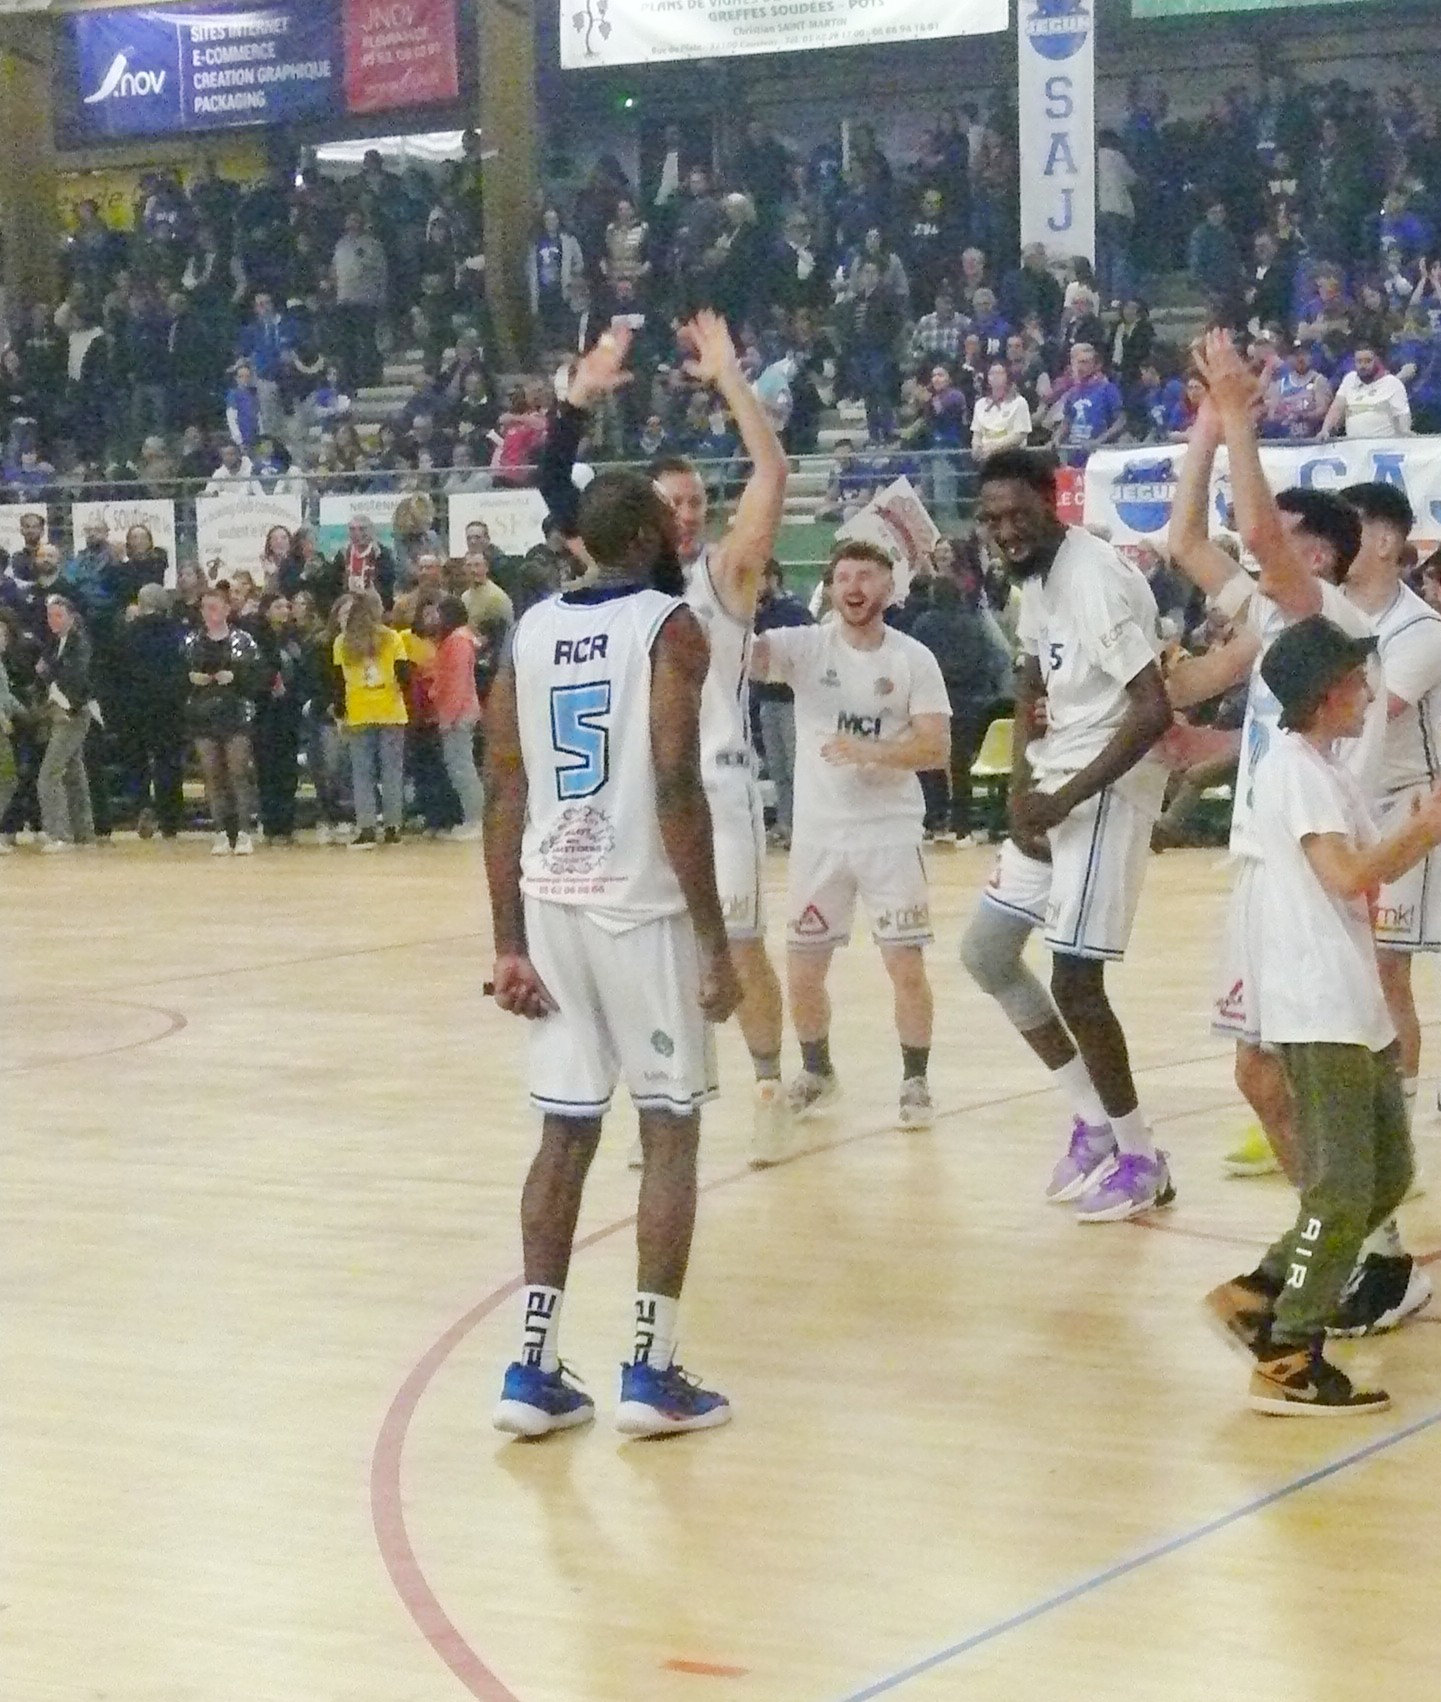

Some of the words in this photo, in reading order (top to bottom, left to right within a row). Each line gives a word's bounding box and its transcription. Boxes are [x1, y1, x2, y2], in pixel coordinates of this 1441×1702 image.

[708, 9, 767, 22] GREFFES
[777, 21, 805, 32] SAINT
[808, 18, 848, 28] MARTIN
[190, 25, 226, 43] SITES
[192, 41, 276, 67] E-COMMERCE
[192, 69, 254, 90] CREATION
[256, 60, 332, 81] GRAPHIQUE
[193, 90, 267, 113] PACKAGING
[1049, 642, 1065, 671] 5
[549, 679, 612, 802] 5
[1286, 1217, 1322, 1290] AIR
